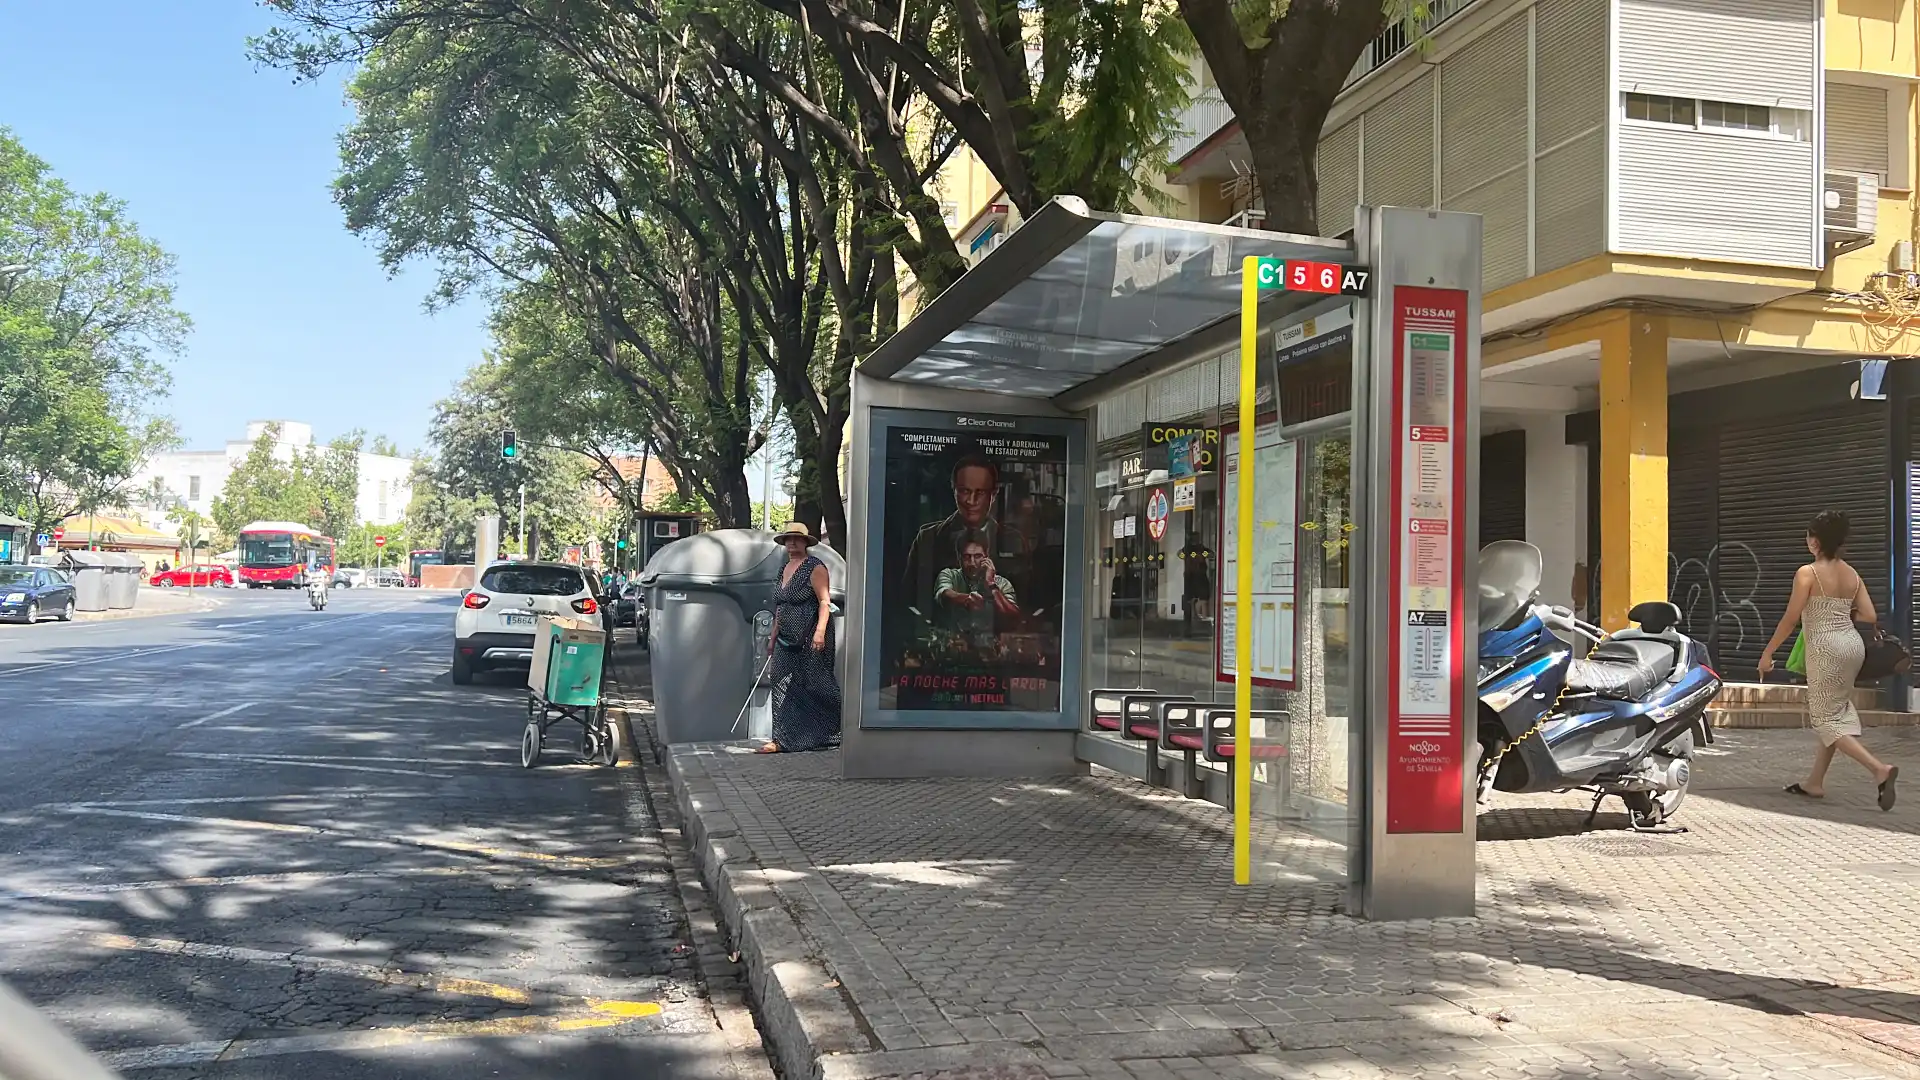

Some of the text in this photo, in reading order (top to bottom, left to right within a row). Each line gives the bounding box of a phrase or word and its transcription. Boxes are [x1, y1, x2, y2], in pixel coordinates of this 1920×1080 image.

[1258, 263, 1369, 291] C1 5 6 A7
[1404, 306, 1456, 318] TUSSAM
[1282, 327, 1302, 340] TUSSAM
[1412, 336, 1427, 347] C1
[967, 418, 1016, 428] Clear Channel
[1411, 427, 1421, 440] 5
[1012, 441, 1050, 449] ADRENALINA
[985, 446, 994, 455] EN
[995, 447, 1018, 456] ESTADO
[1411, 519, 1420, 533] 6
[1408, 611, 1425, 622] A7
[913, 676, 959, 688] NOCHE
[970, 693, 1004, 704] NETFLIX
